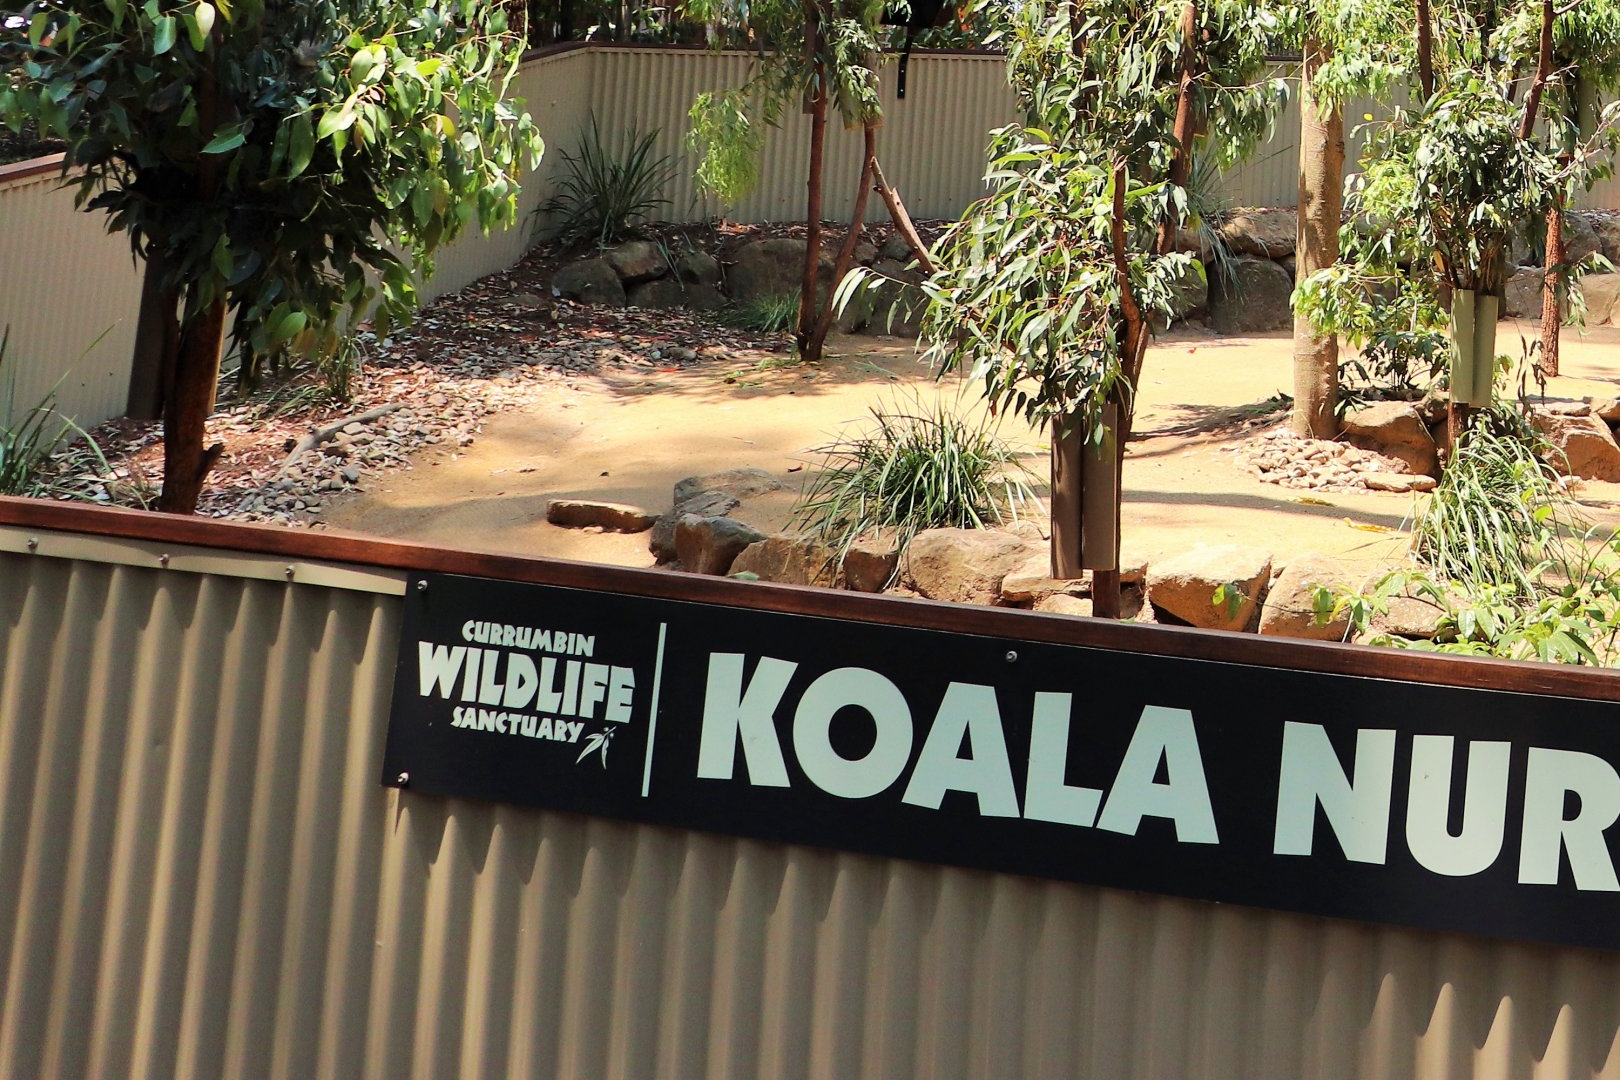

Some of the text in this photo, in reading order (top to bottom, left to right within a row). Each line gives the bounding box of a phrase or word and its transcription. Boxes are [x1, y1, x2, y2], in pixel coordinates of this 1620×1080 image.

[462, 620, 595, 657] CURRUMBIN
[418, 641, 635, 723] WILDLIFE
[450, 706, 585, 743] SANCTUARY
[697, 652, 1220, 845] KOALA
